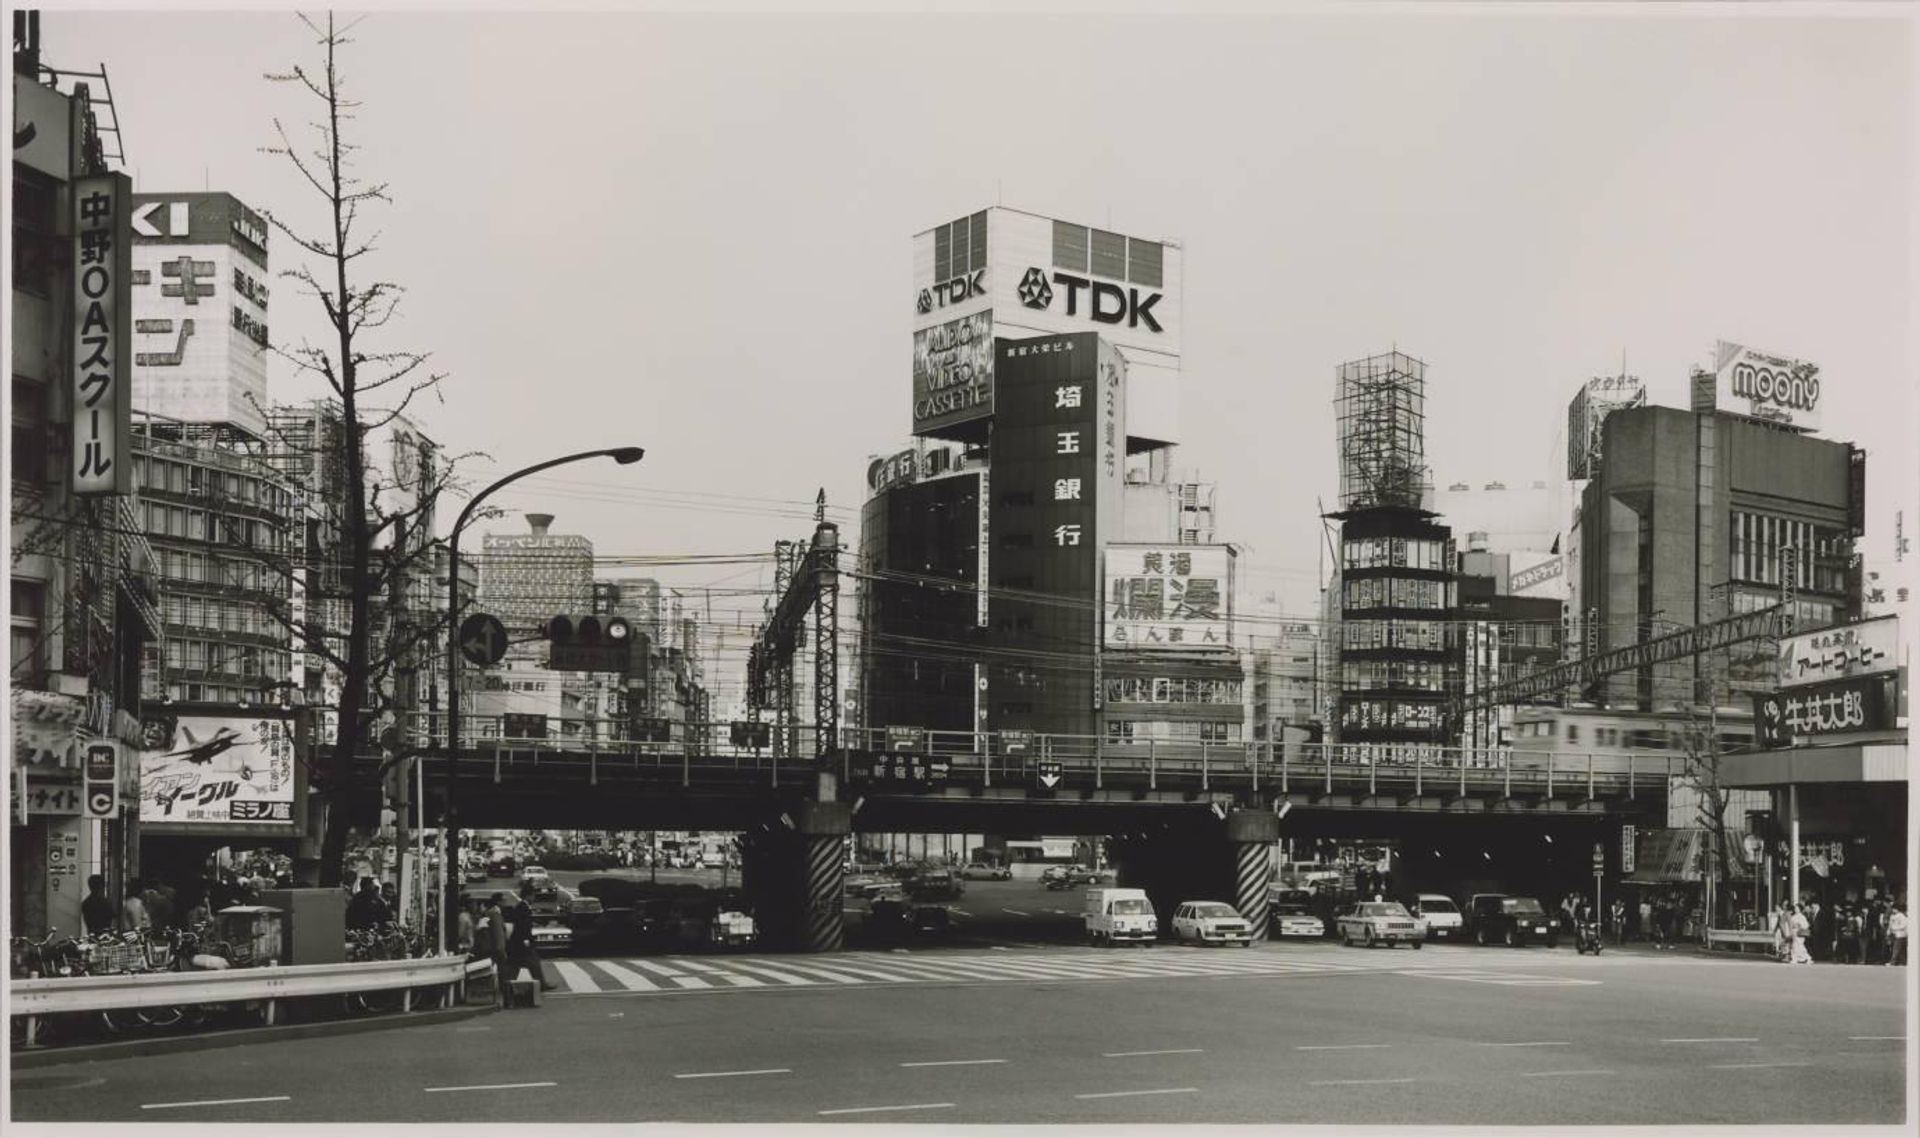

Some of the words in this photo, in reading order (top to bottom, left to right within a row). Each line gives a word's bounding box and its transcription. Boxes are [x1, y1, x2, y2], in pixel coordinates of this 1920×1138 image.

[933, 269, 987, 309] TDK
[1052, 271, 1164, 334] TDK
[79, 191, 112, 480] 中野OAスクール
[926, 362, 973, 392] VIDEO
[914, 384, 993, 420] CASSETTE
[1054, 385, 1082, 547] 埼玉銀行
[1797, 647, 1884, 677] アートコーヒー
[1785, 690, 1864, 733] 牛丼太郎
[232, 802, 291, 819] ミラノ座
